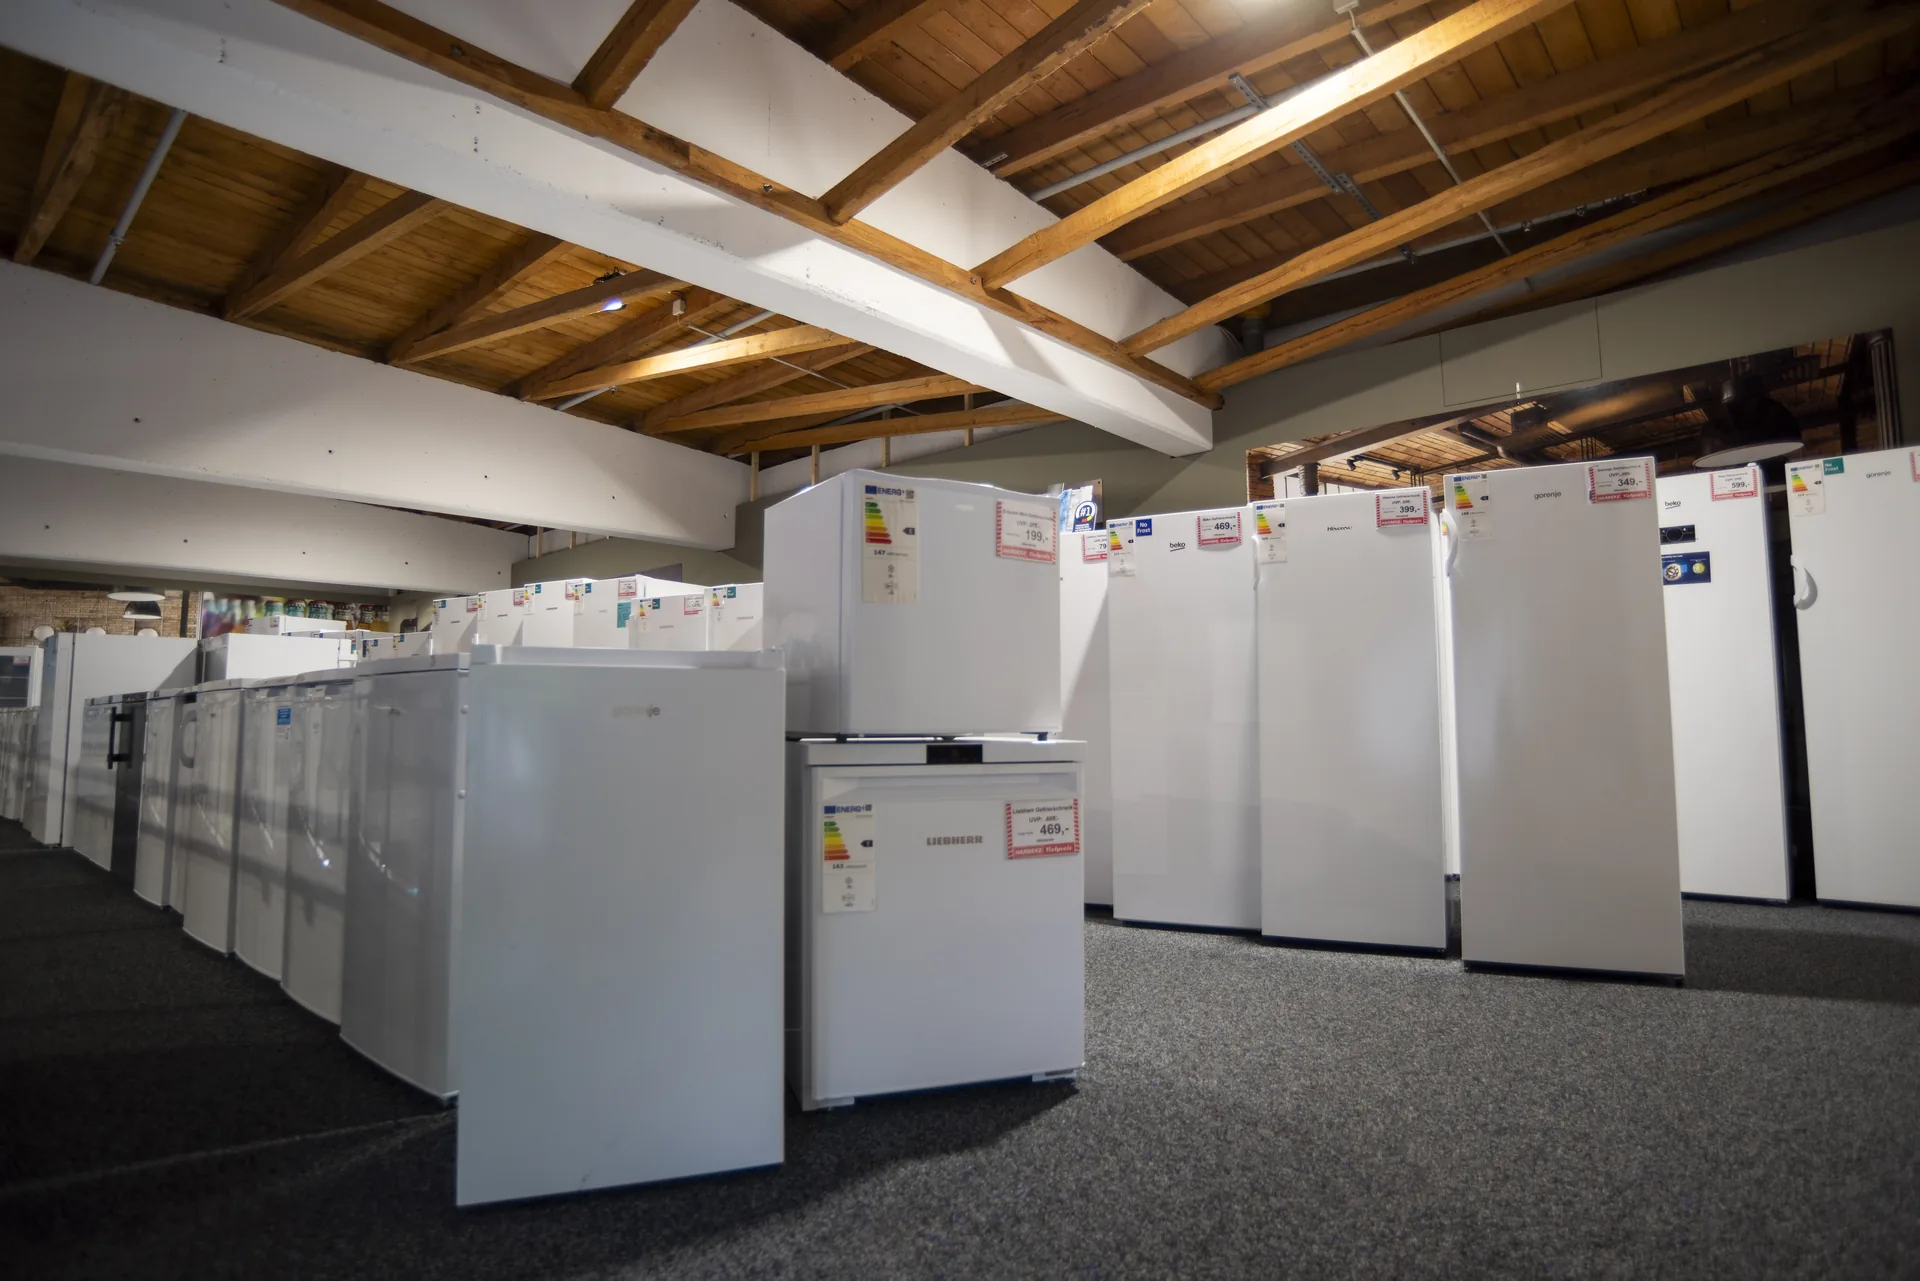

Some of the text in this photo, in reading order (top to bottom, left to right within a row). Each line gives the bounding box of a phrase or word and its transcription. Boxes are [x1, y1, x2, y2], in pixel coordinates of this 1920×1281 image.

[1866, 470, 1892, 478] gorenje
[1534, 491, 1562, 500] gorenje
[1080, 507, 1091, 517] #1
[1399, 505, 1420, 513] 399,-
[1214, 522, 1236, 530] 469,-
[1025, 529, 1049, 543] 199,-
[1040, 823, 1070, 836] 469,-
[926, 835, 983, 846] LIEBHERR
[1045, 845, 1072, 853] Tiefpreis
